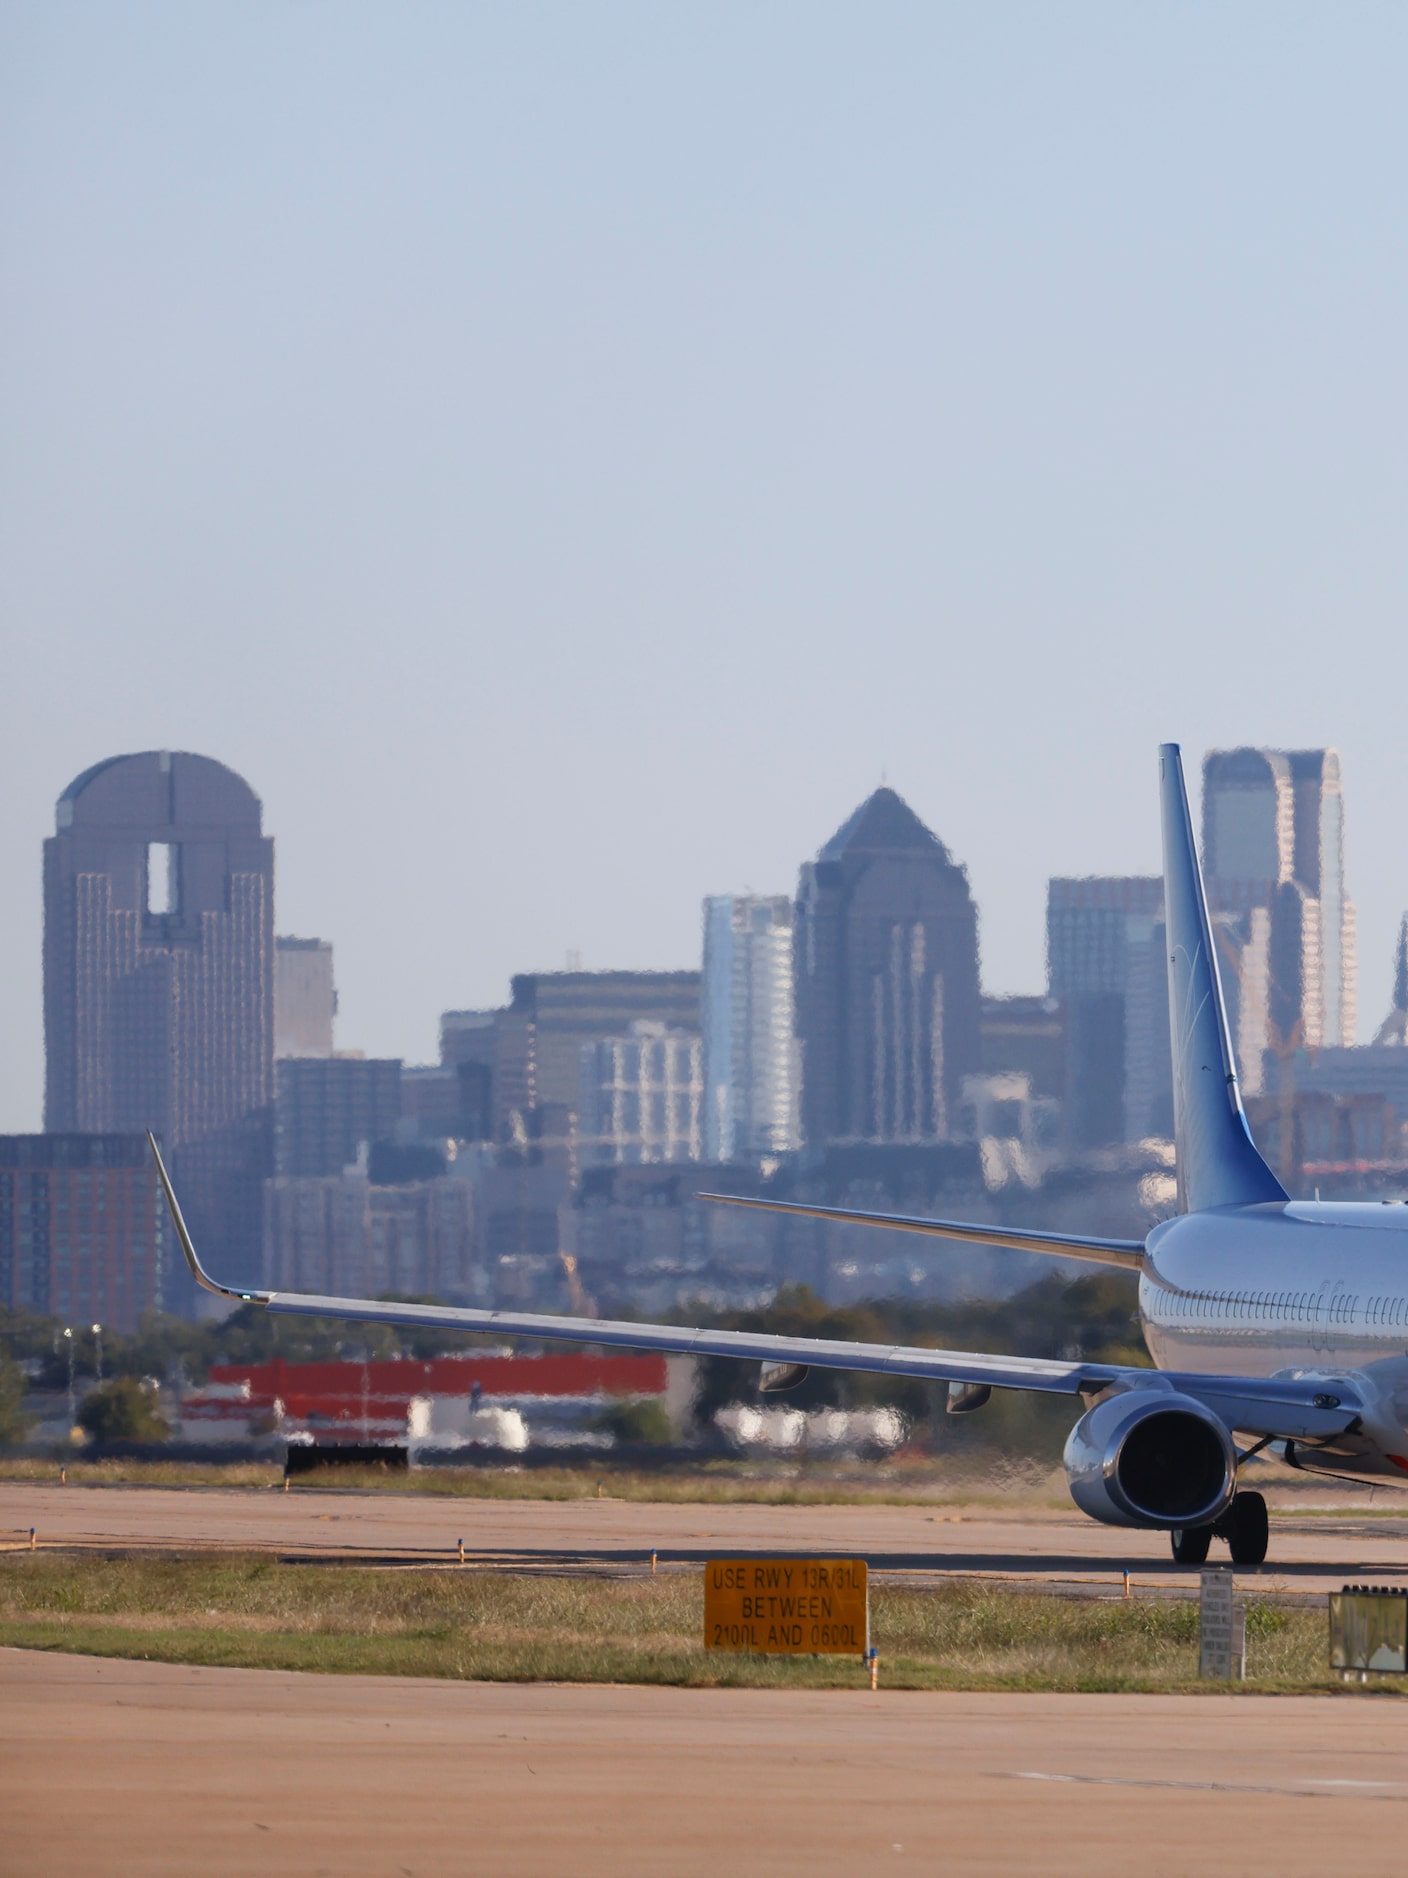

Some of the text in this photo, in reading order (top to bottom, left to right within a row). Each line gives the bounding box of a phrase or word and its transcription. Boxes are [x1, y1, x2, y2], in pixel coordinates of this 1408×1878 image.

[713, 1568, 860, 1590] USE RWY 13R/31L
[742, 1597, 832, 1618] BETWEEN
[714, 1624, 859, 1646] 2100L AND 0600L
